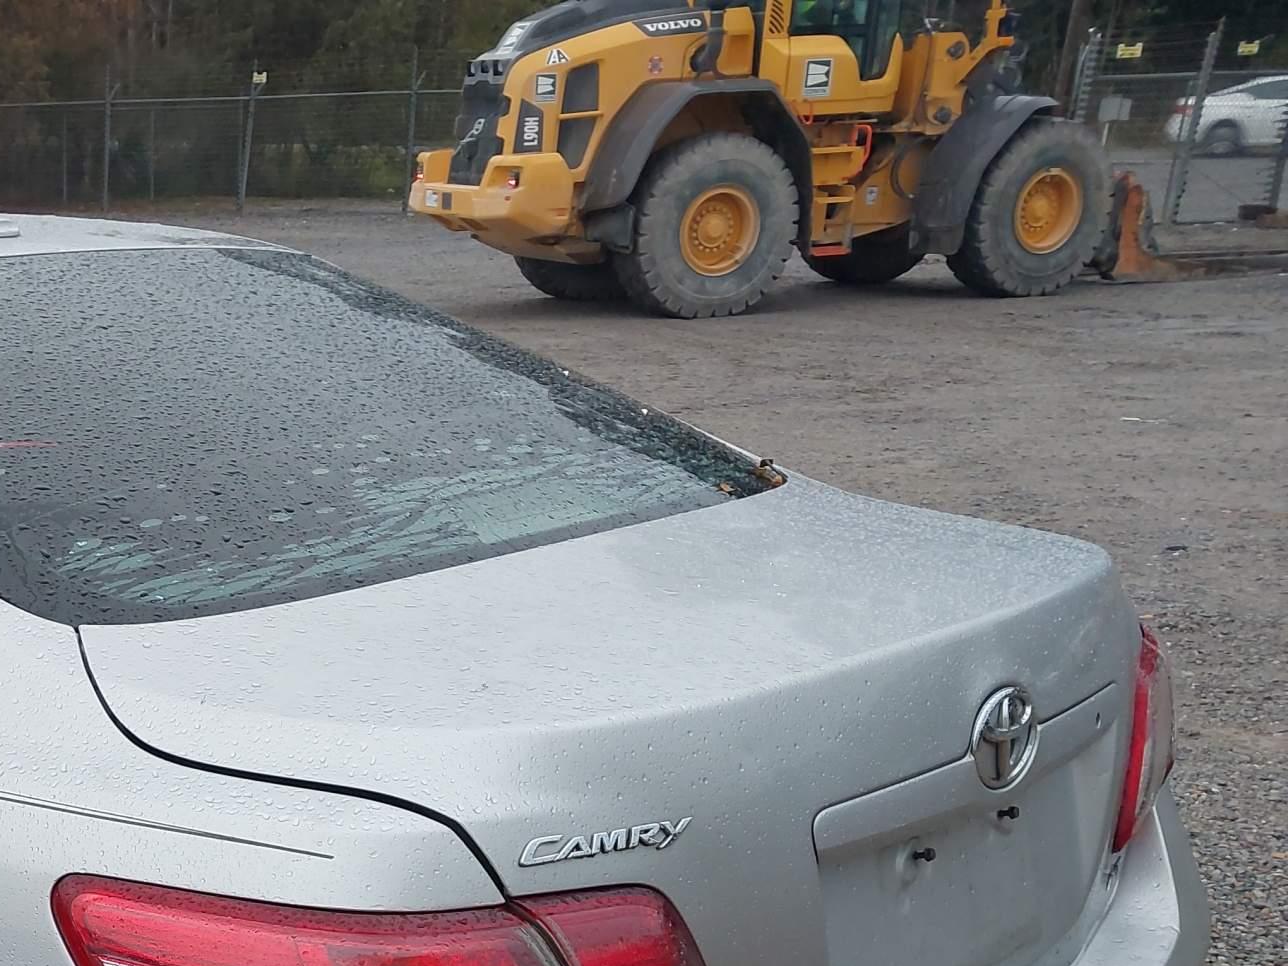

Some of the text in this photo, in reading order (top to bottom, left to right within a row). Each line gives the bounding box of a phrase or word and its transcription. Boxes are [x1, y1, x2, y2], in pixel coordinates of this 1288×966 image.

[643, 18, 702, 32] VOLVO
[523, 116, 540, 147] L90H
[518, 815, 697, 867] CAMRY
